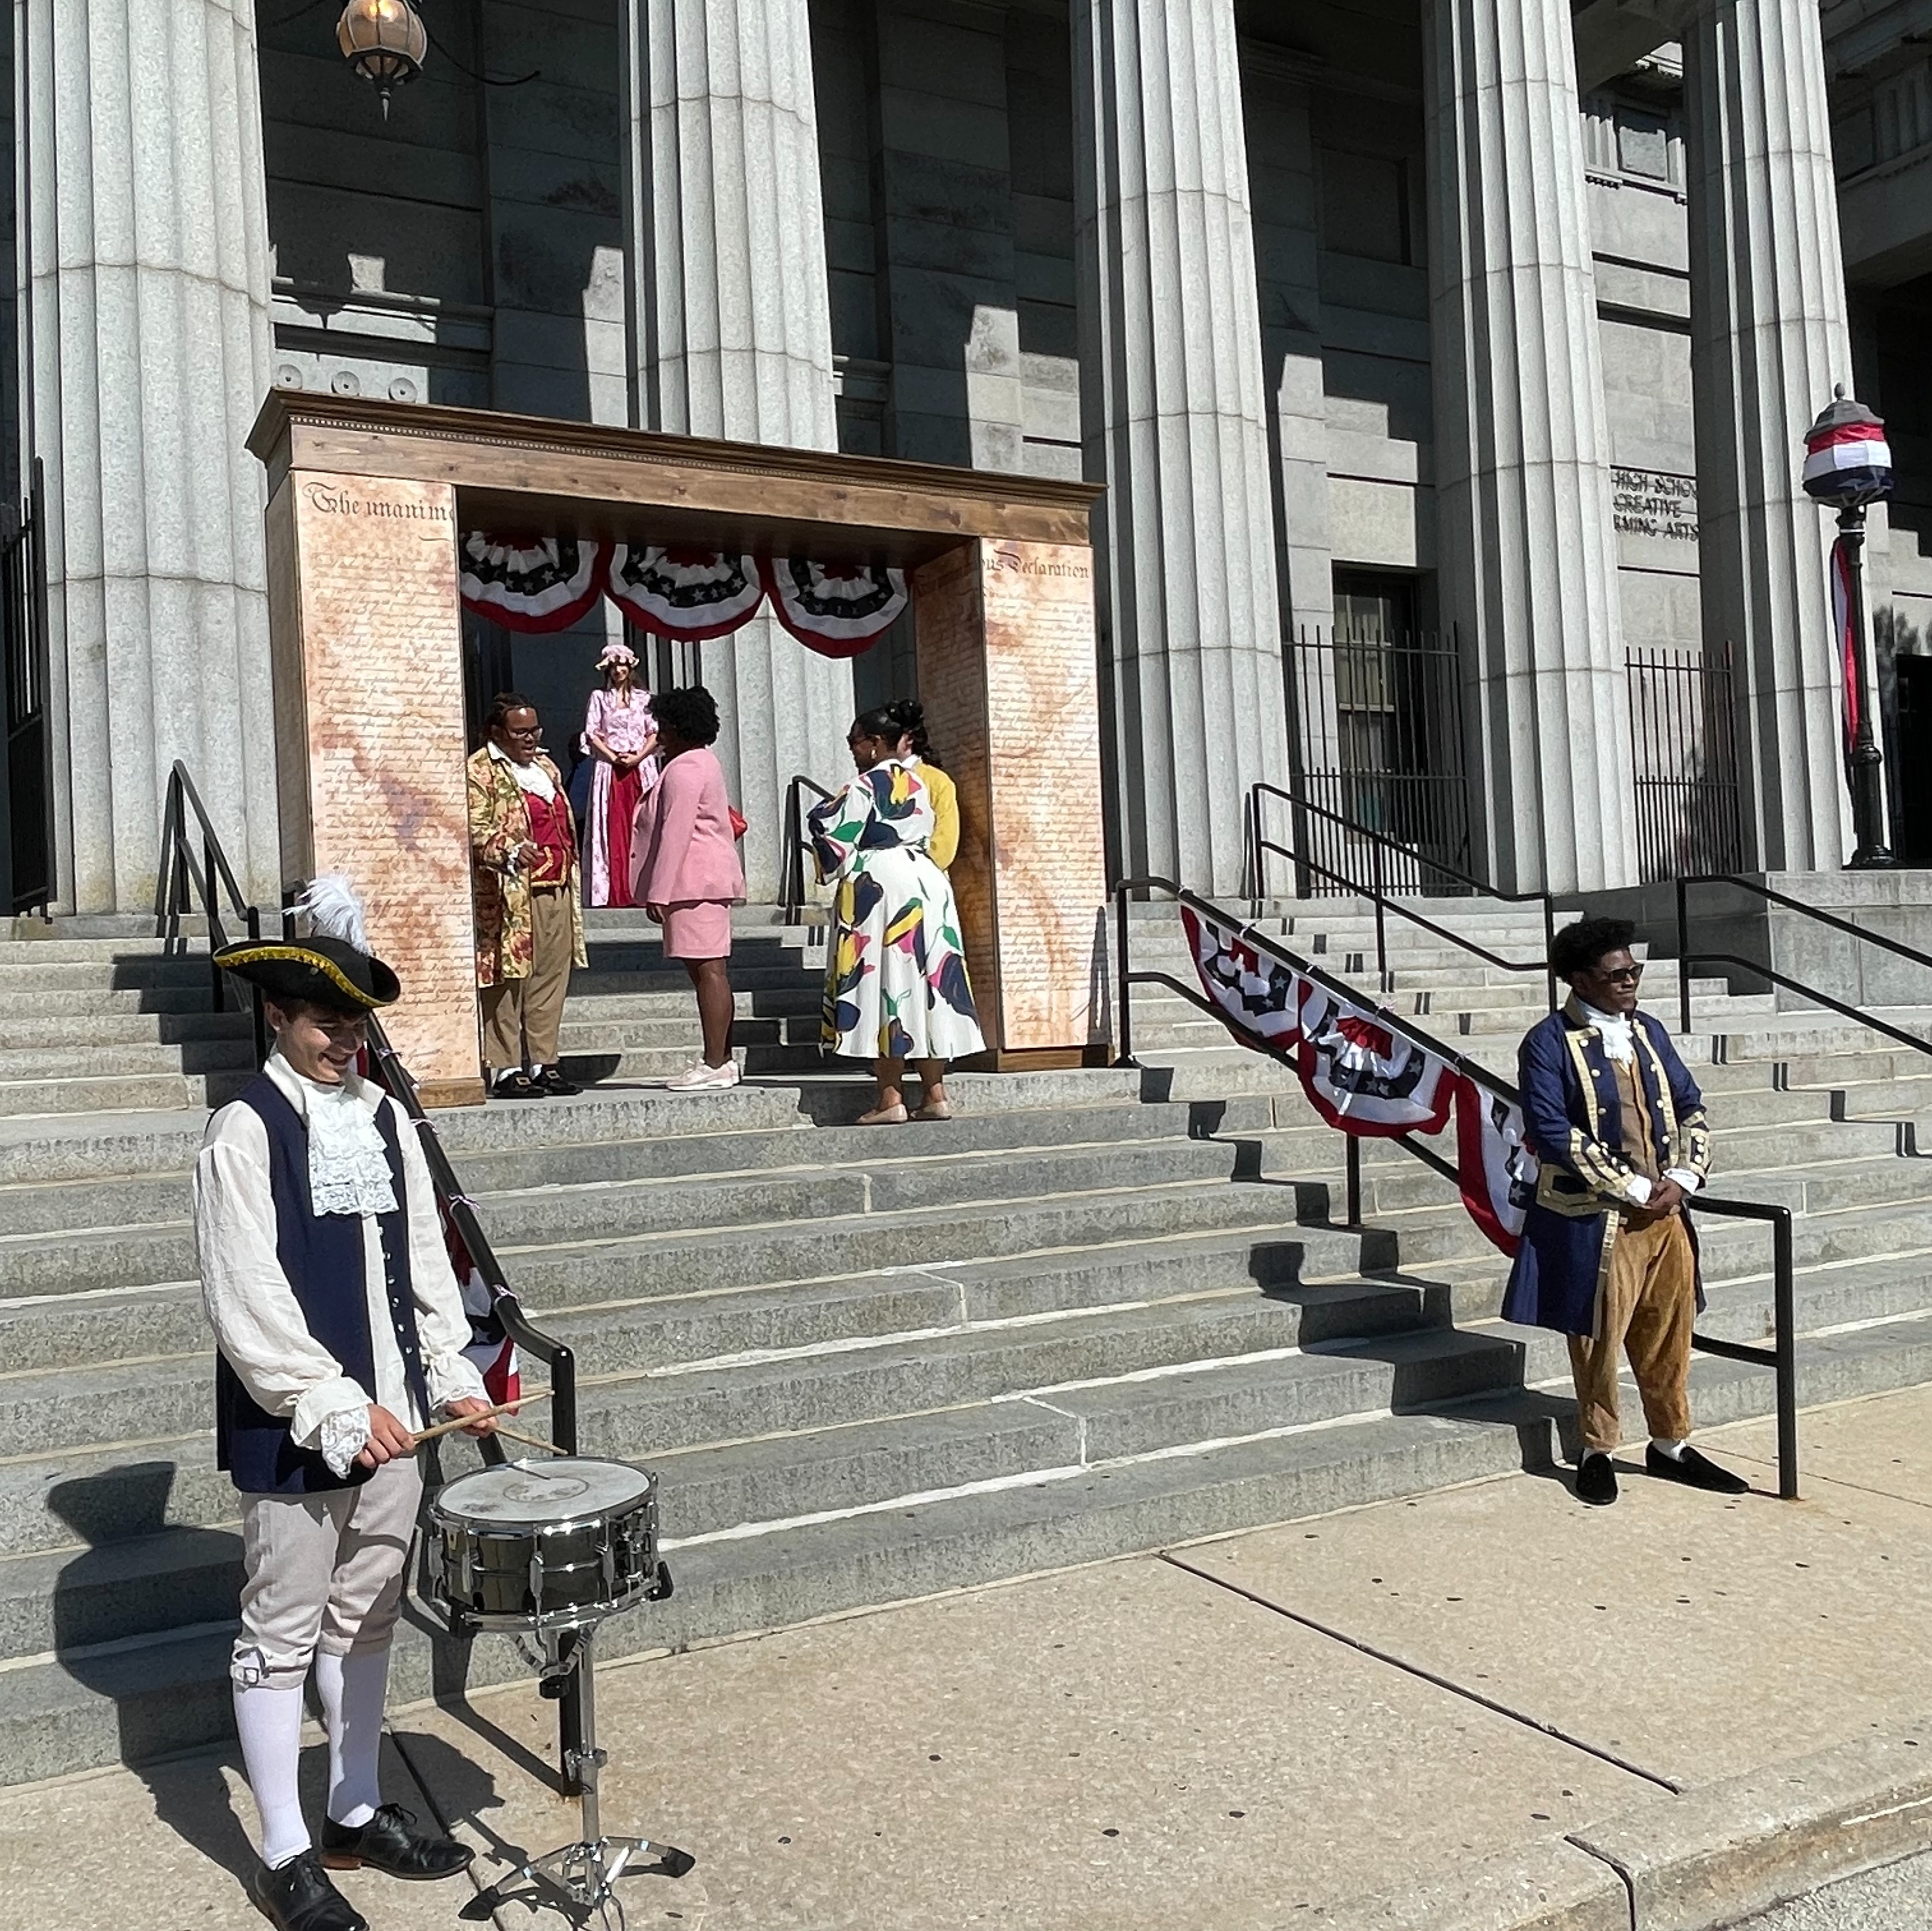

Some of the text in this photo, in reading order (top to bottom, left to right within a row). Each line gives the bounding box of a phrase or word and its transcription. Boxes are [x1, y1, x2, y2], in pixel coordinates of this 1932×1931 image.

[1615, 471, 1648, 492] HIGH
[302, 482, 359, 515] The
[1613, 493, 1681, 518] CREATIVE
[1663, 521, 1699, 541] ARTS
[994, 549, 1089, 579] Declaration
